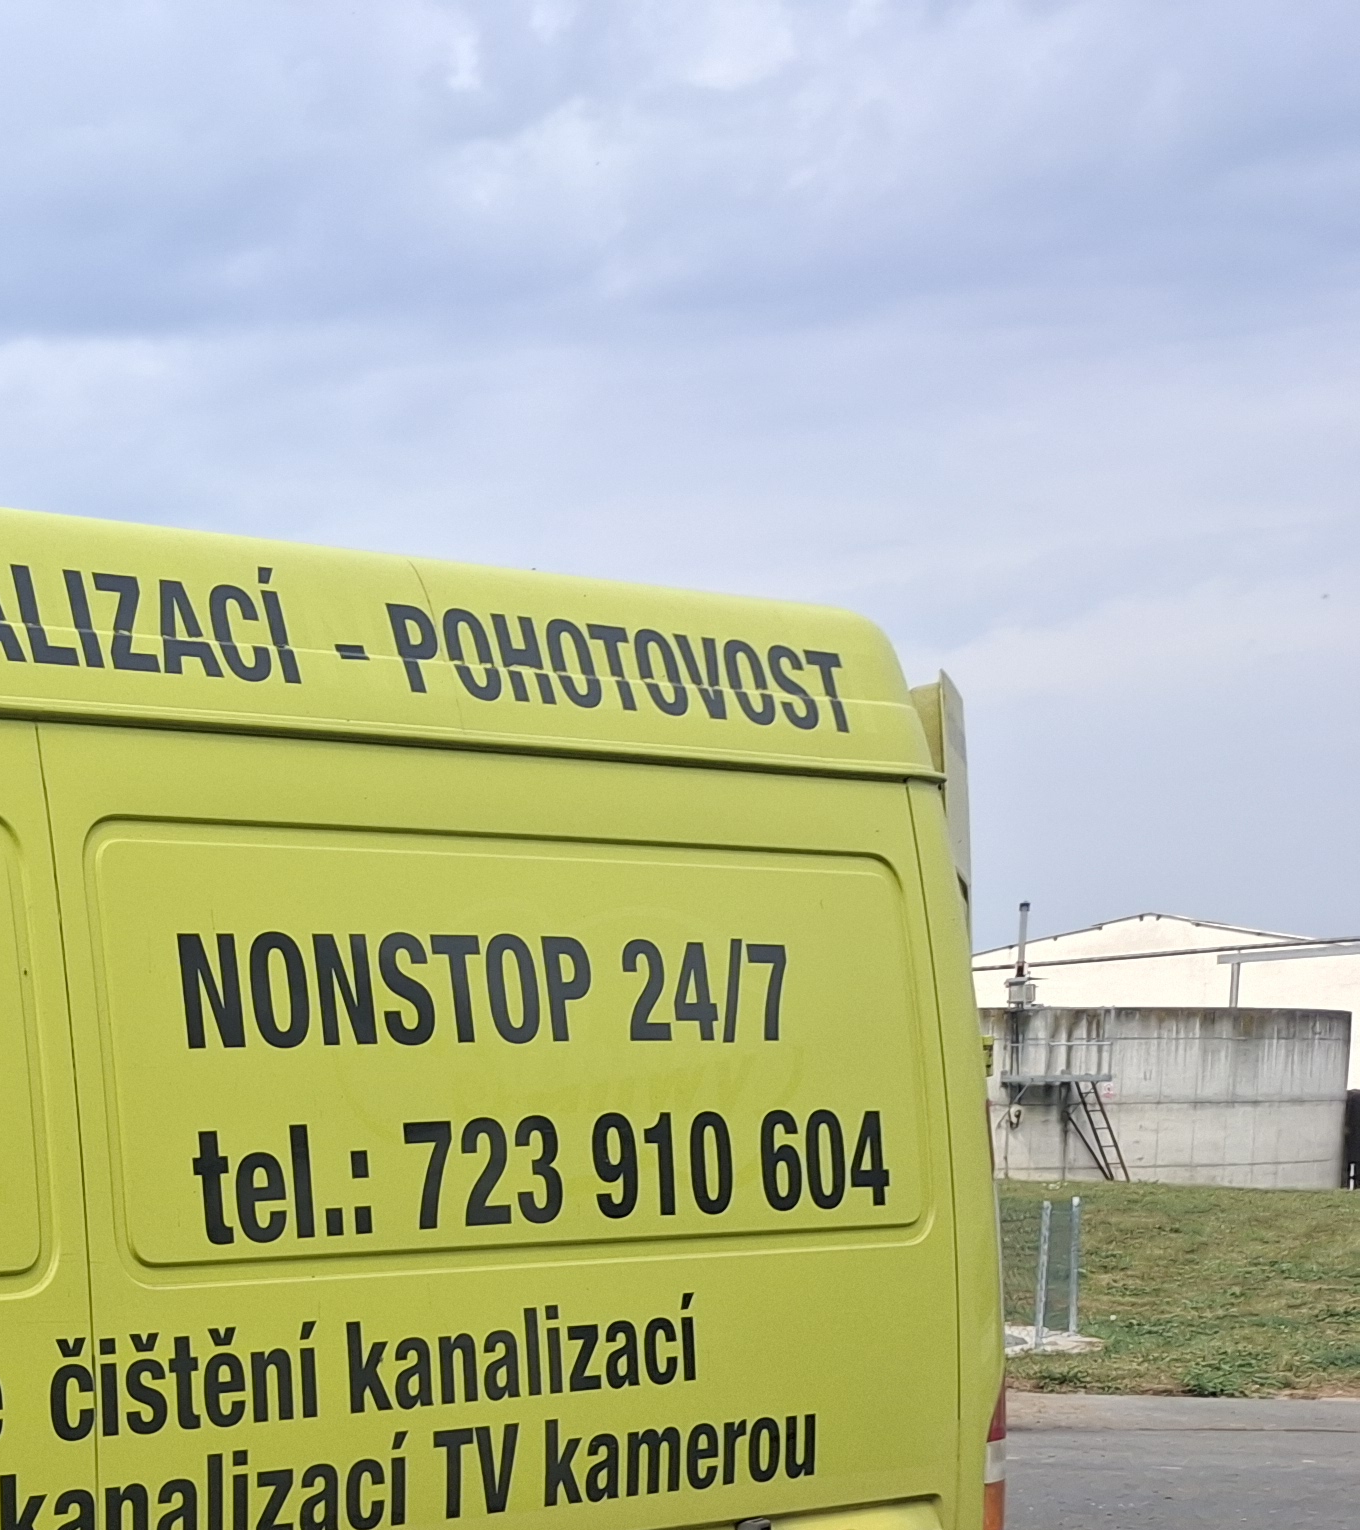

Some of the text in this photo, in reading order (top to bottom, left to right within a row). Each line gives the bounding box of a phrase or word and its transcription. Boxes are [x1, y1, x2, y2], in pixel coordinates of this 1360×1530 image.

[386, 602, 849, 733] POHOTOVOST
[176, 931, 787, 1050] NONSTOP 24/7
[192, 1108, 890, 1246] tel.: 723 910 604
[49, 1320, 319, 1443] čištění
[345, 1292, 698, 1414] kanalizací
[432, 1422, 520, 1520] TV
[543, 1412, 817, 1508] kamerou
